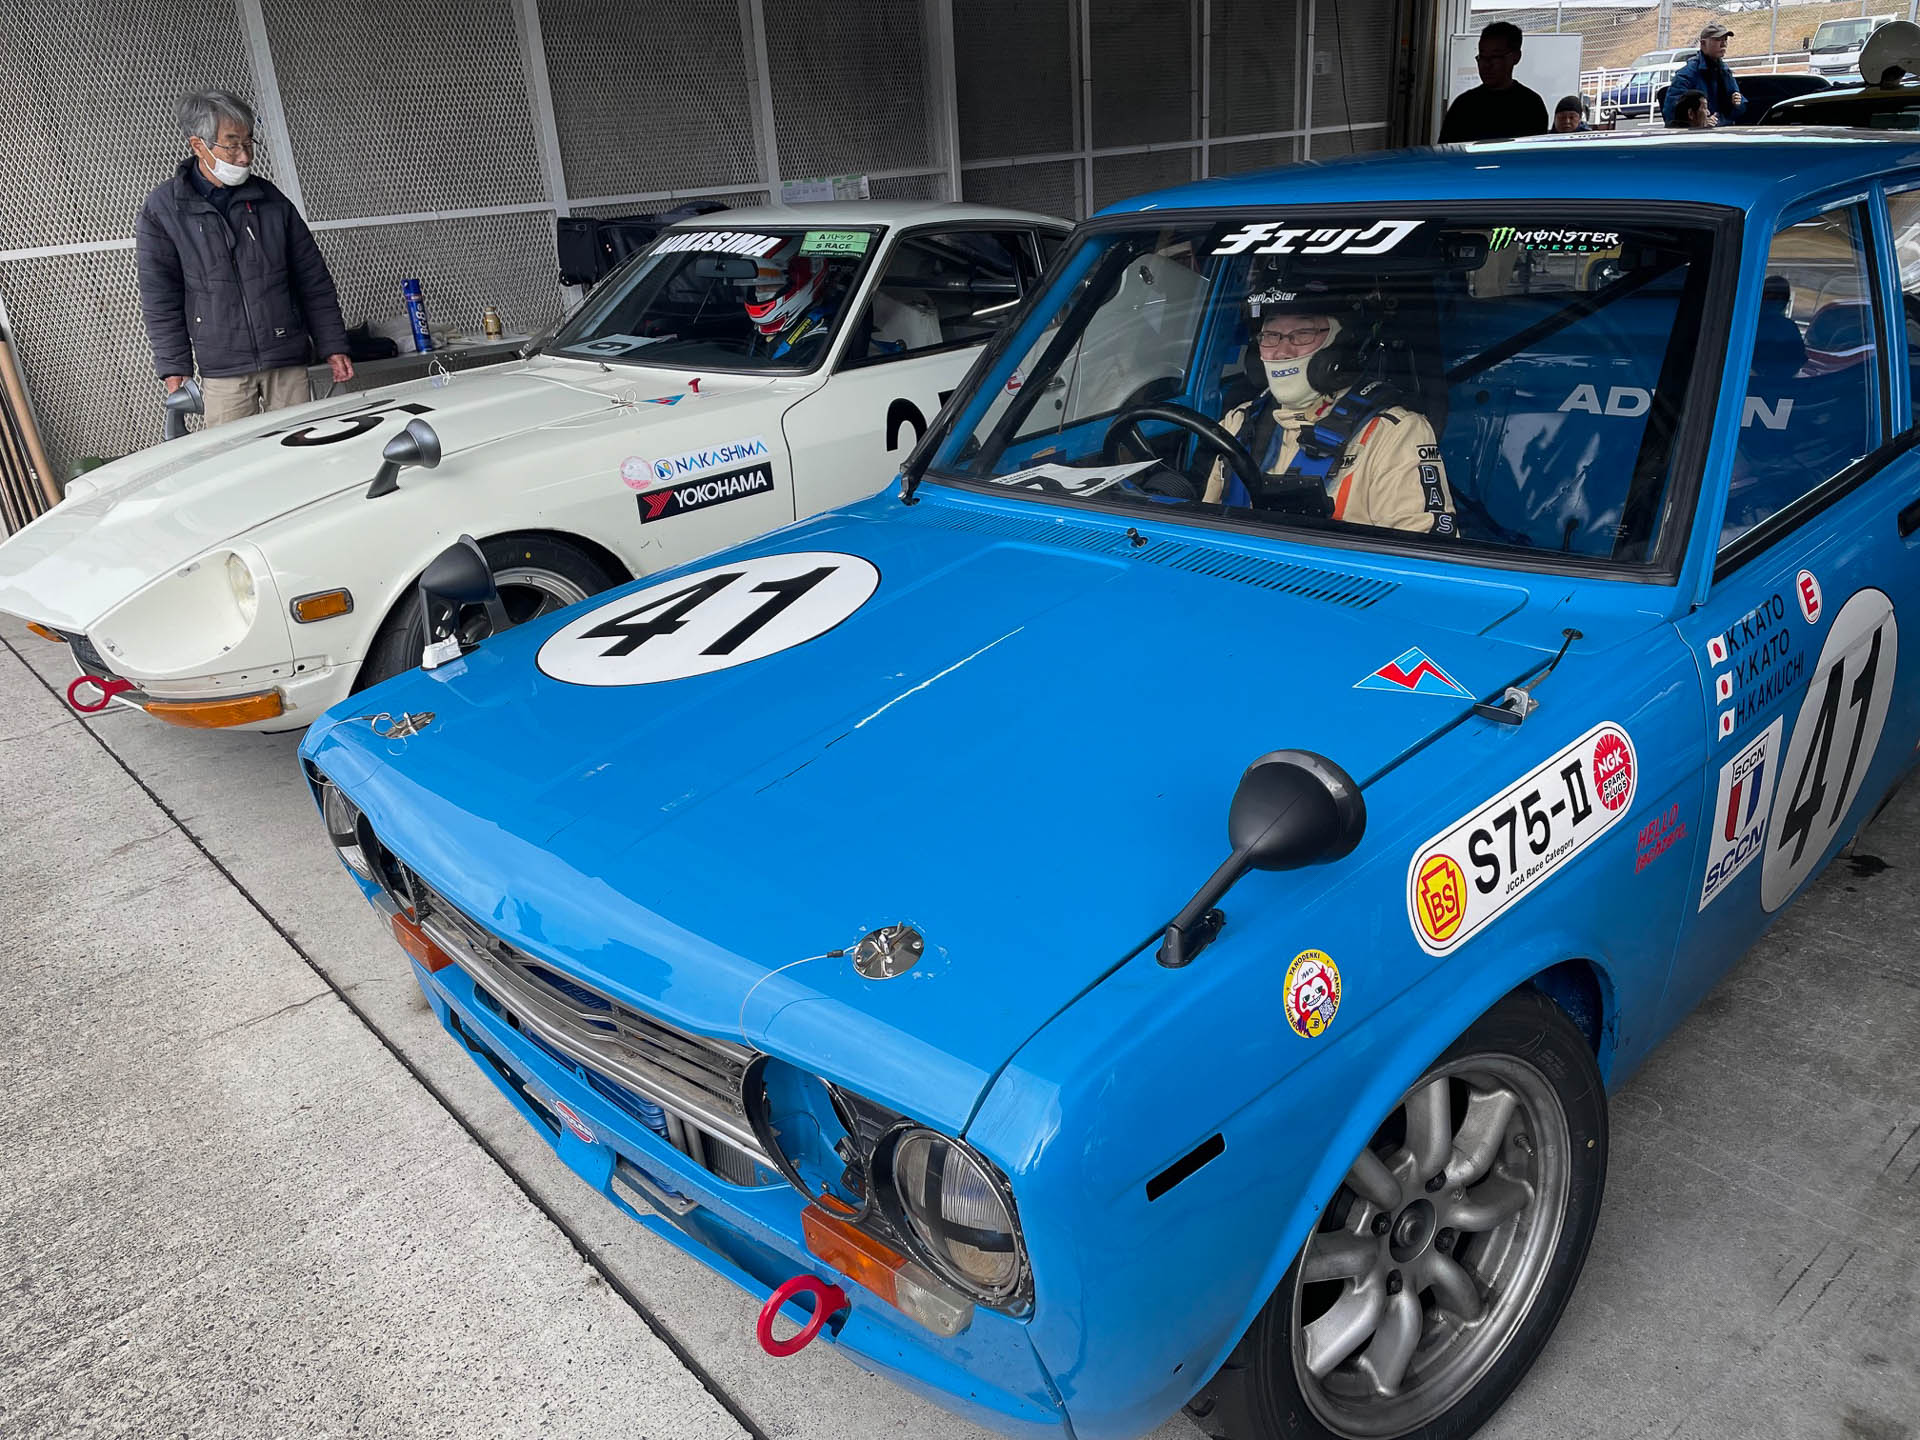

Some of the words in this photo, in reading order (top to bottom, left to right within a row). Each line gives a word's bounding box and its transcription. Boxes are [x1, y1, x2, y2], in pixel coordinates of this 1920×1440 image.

[824, 242, 852, 250] RACE
[1210, 220, 1426, 255] チェック
[675, 440, 768, 474] NAKASHIMA
[673, 470, 768, 508] YOKOHAMA
[576, 566, 841, 658] 41
[1800, 577, 1819, 615] E
[1736, 628, 1790, 689] Y.KATO
[1736, 651, 1805, 729] H.KAKIUCHI
[1598, 747, 1624, 778] NGK
[1734, 744, 1766, 781] SCCN
[1778, 624, 1884, 870] 41
[1603, 769, 1626, 793] SPARK
[1605, 779, 1628, 803] PLUGS
[1637, 803, 1680, 853] HELLO
[1505, 873, 1526, 895] JCCA
[1526, 860, 1544, 880] Race
[1545, 836, 1574, 865] Category
[1704, 817, 1766, 893] SCCN
[1430, 884, 1456, 923] BS
[1289, 952, 1320, 976] YANODENKI
